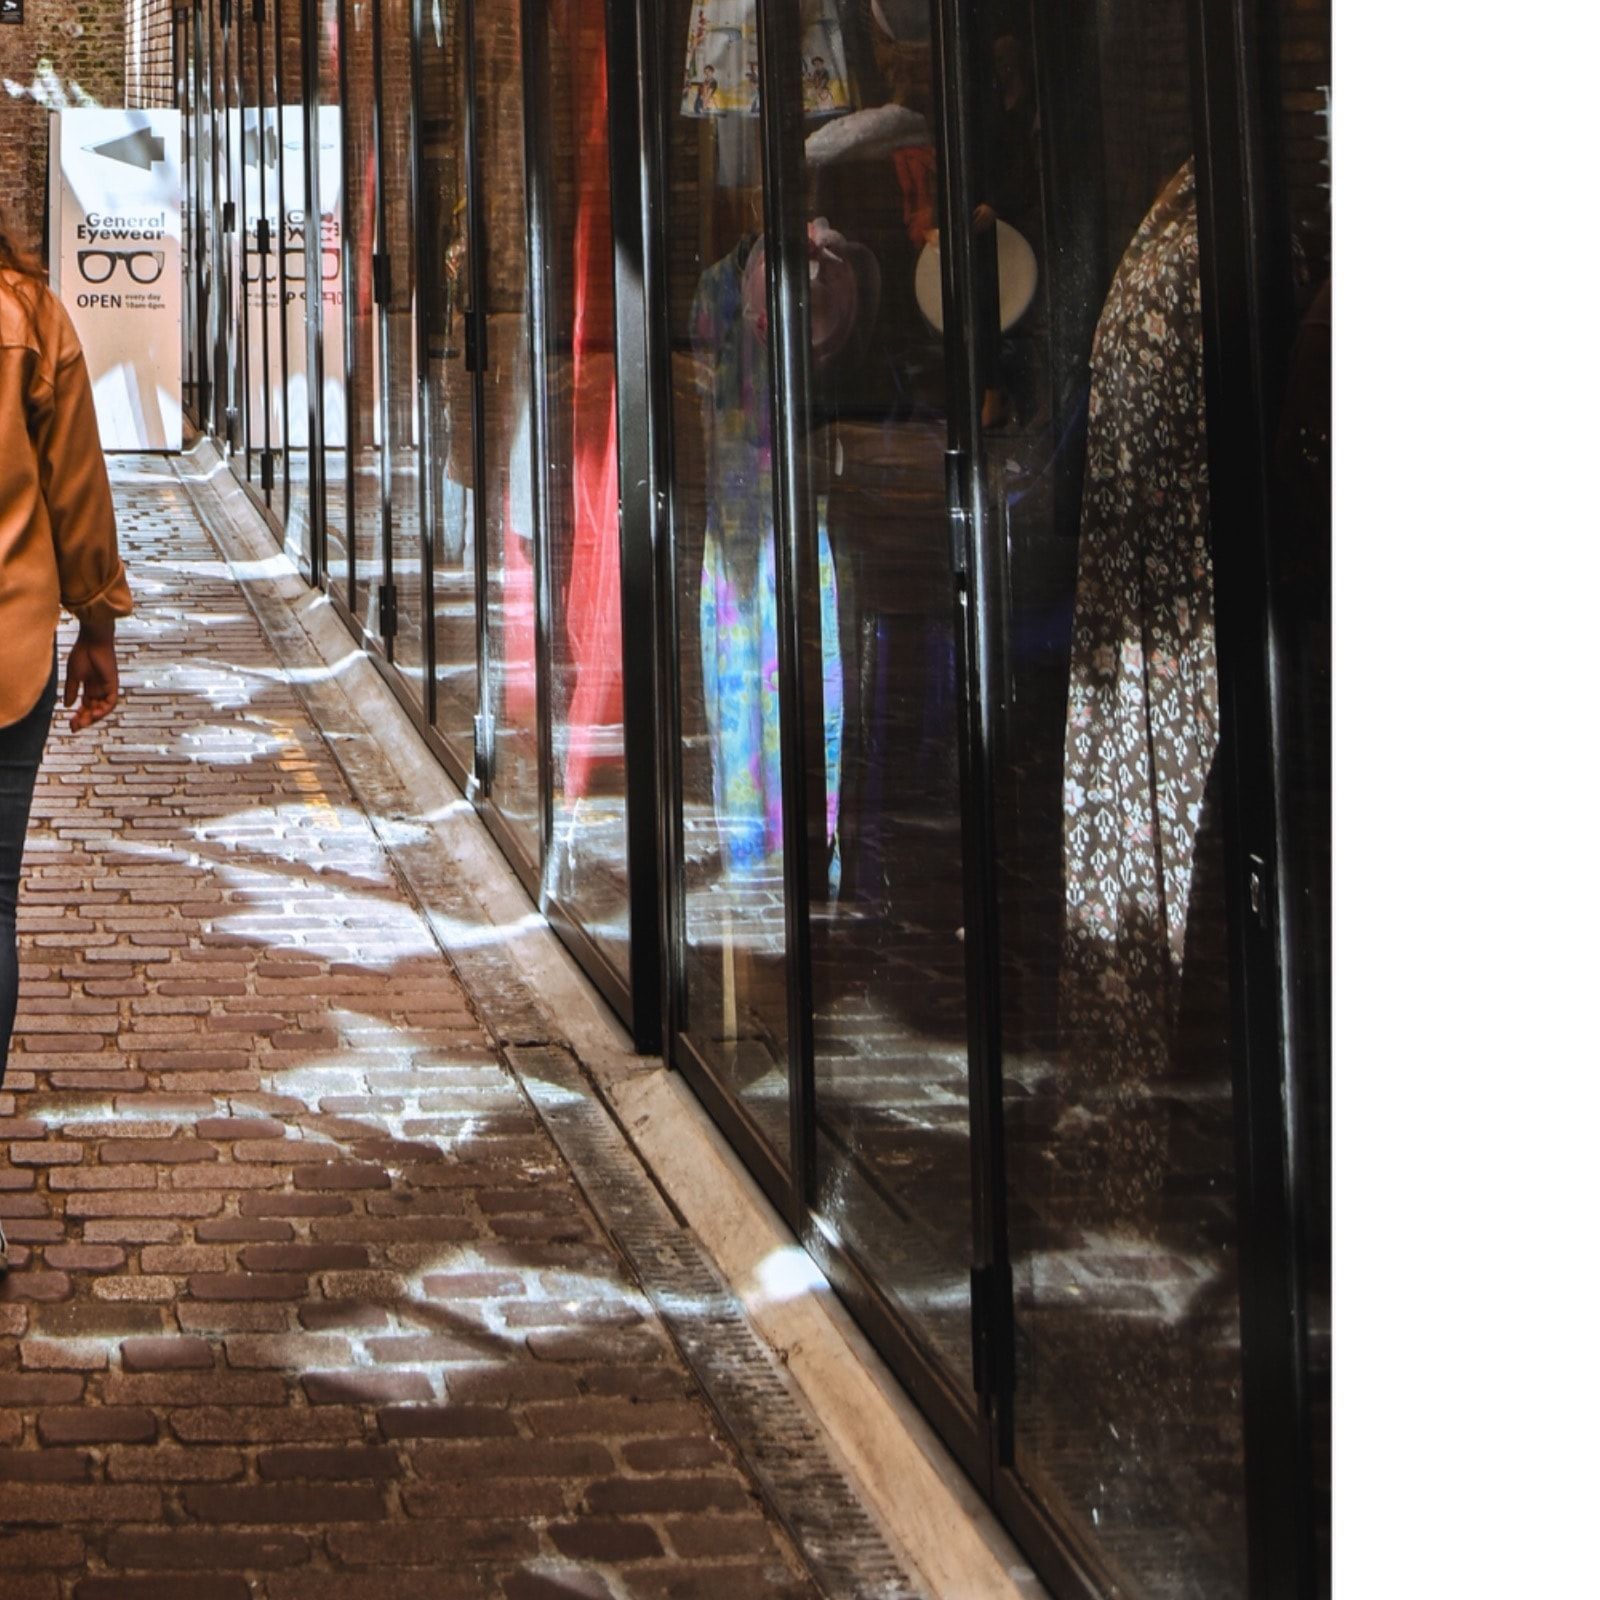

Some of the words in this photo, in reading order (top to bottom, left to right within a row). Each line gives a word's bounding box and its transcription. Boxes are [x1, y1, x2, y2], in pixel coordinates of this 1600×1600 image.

[86, 212, 165, 228] General
[77, 224, 165, 244] Eyewear
[77, 294, 122, 309] OPEN
[147, 293, 161, 301] day
